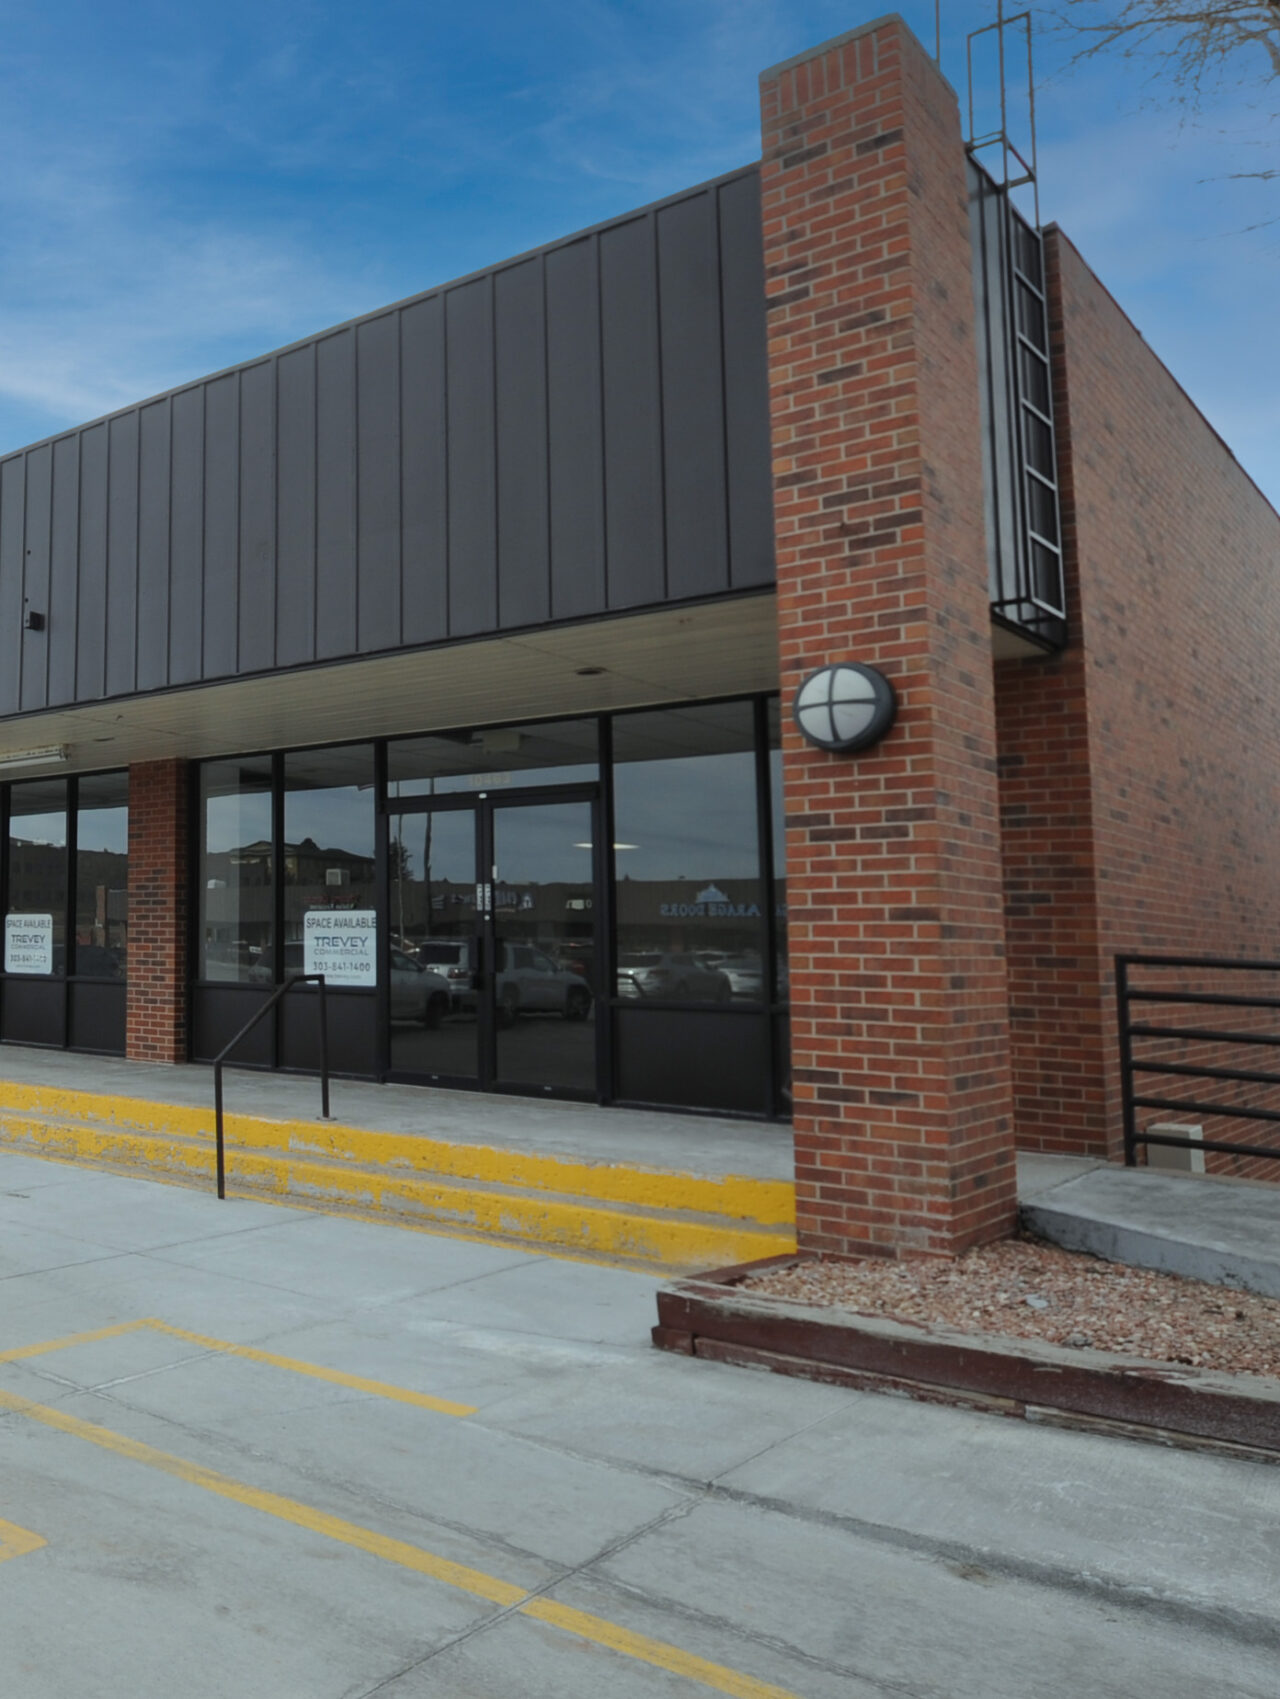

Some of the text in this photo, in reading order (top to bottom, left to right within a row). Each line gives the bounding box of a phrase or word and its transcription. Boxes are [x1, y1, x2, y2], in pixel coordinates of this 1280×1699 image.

[6, 919, 22, 928] SPACE
[306, 917, 377, 928] SPACE AVAILABLE
[11, 934, 45, 943] TREVEY
[314, 936, 368, 947] TREVEY
[314, 948, 369, 956] COMMERCIAL
